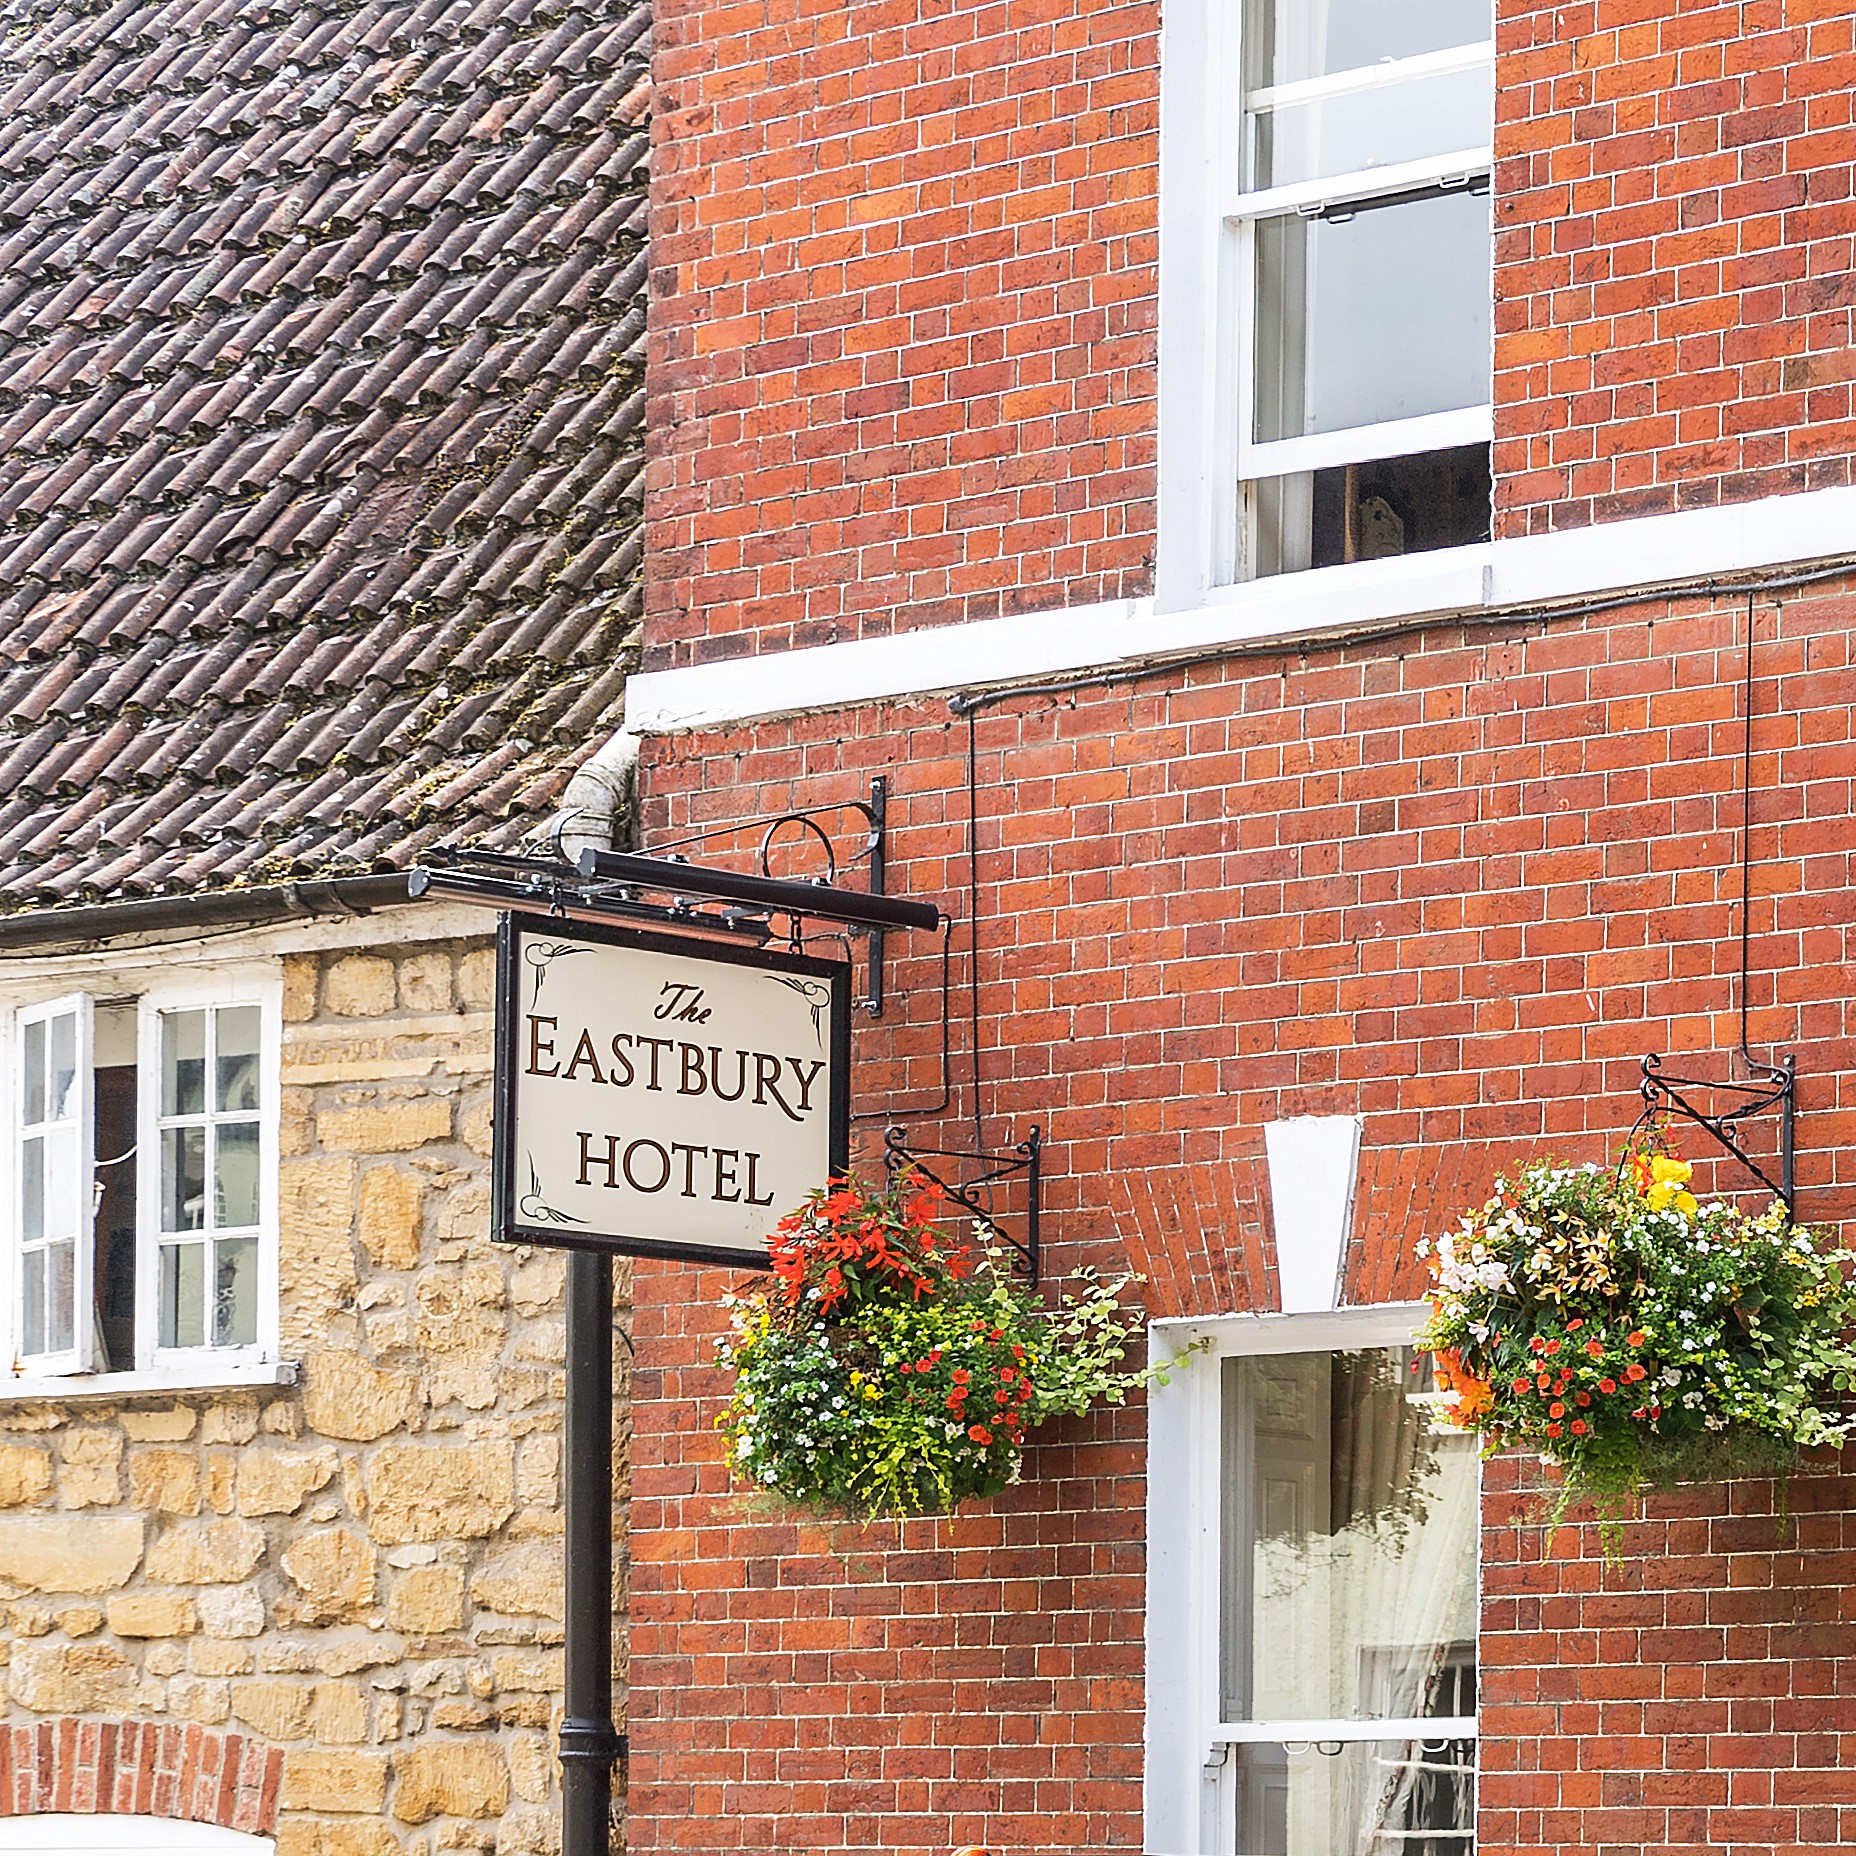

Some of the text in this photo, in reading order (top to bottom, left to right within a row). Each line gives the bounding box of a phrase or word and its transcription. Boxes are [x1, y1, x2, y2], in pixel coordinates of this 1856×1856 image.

[654, 981, 712, 1025] The
[524, 1014, 826, 1122] EASTBURY
[575, 1132, 775, 1207] HOTEL
